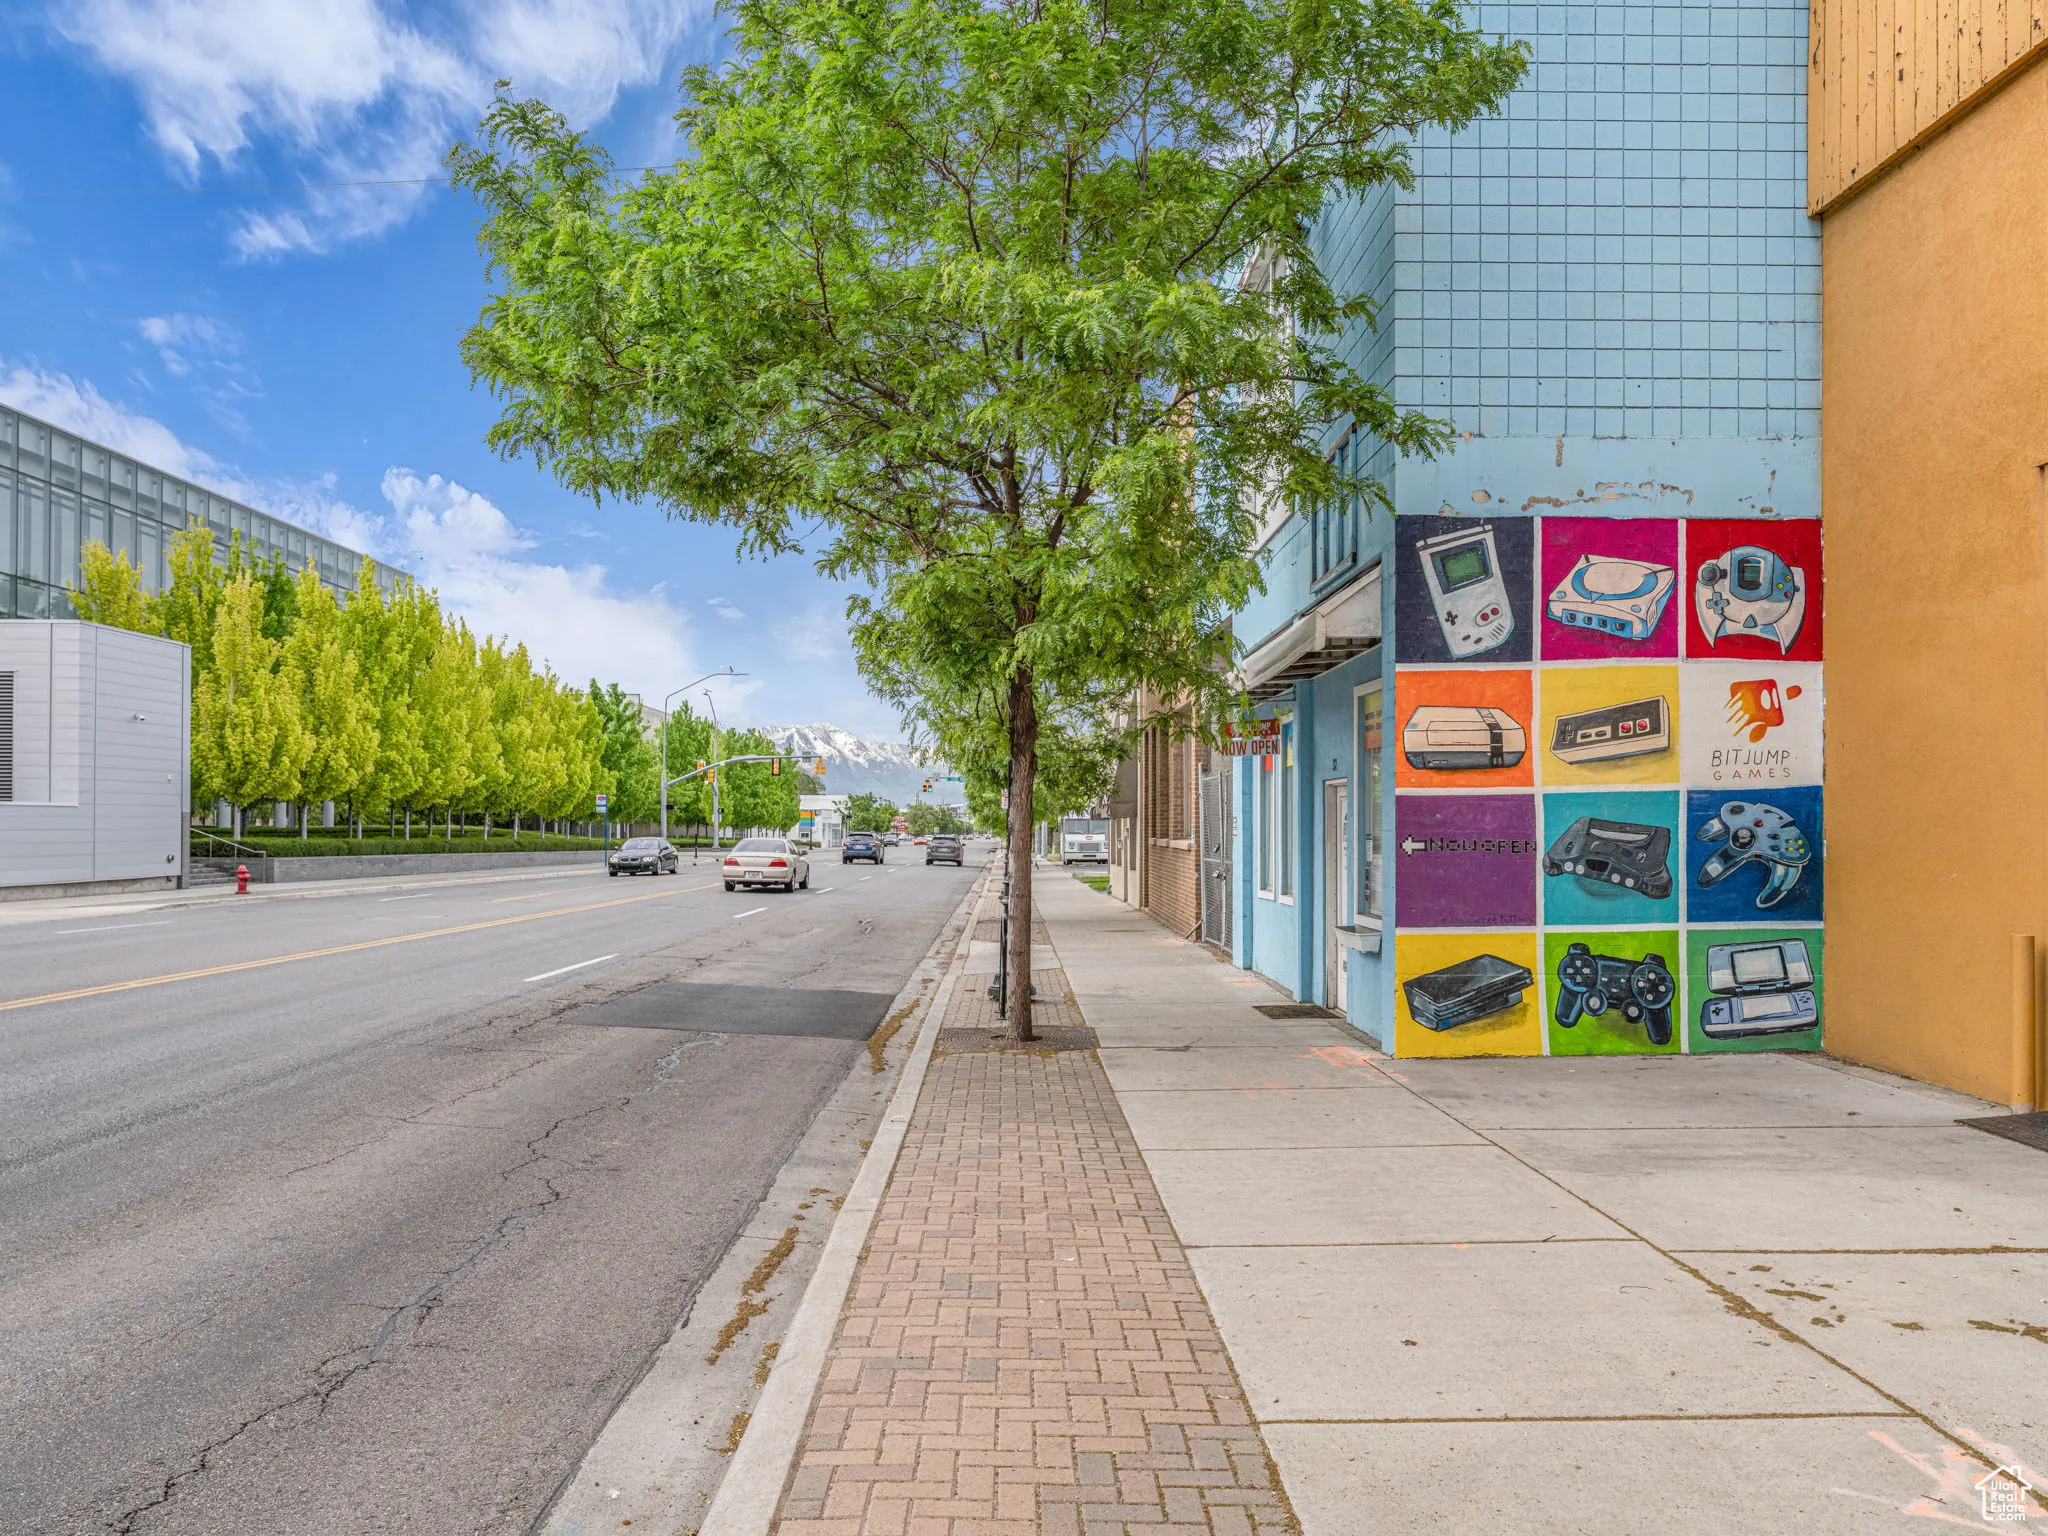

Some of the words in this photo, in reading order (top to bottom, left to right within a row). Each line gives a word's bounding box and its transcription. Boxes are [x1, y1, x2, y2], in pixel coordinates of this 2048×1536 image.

[1222, 741, 1247, 757] NOW
[1252, 740, 1278, 755] OPEN
[1711, 749, 1790, 767] BITJUMP
[1713, 768, 1791, 780] GAMES
